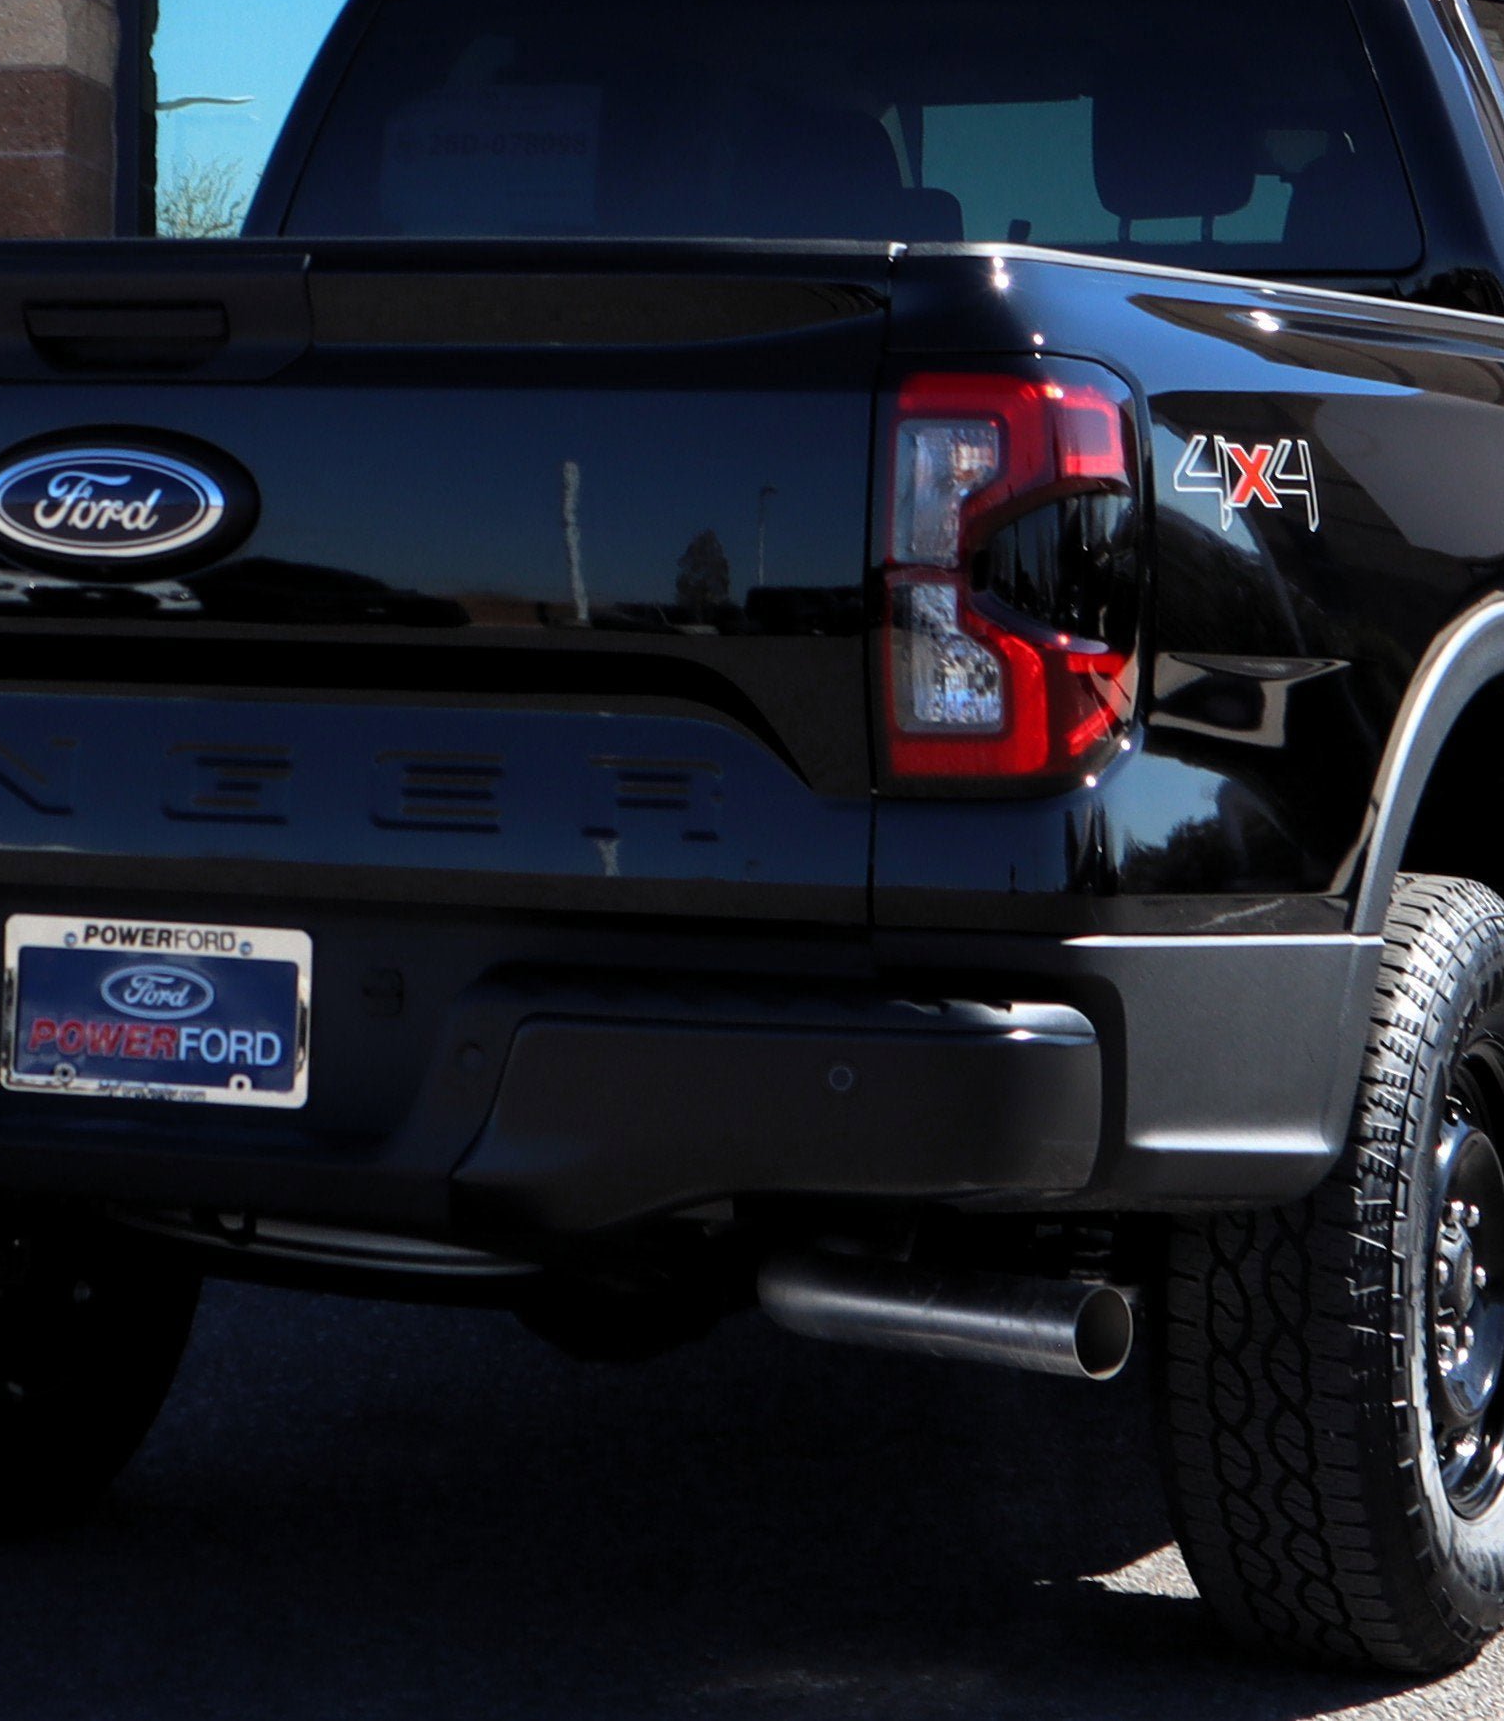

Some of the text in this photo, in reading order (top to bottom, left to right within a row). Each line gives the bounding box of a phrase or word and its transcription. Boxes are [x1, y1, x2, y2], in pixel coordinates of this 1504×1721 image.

[33, 470, 161, 531] Ford
[83, 924, 237, 953] POWERFORD
[123, 974, 192, 1008] Ford
[29, 1018, 282, 1066] POWERFORD
